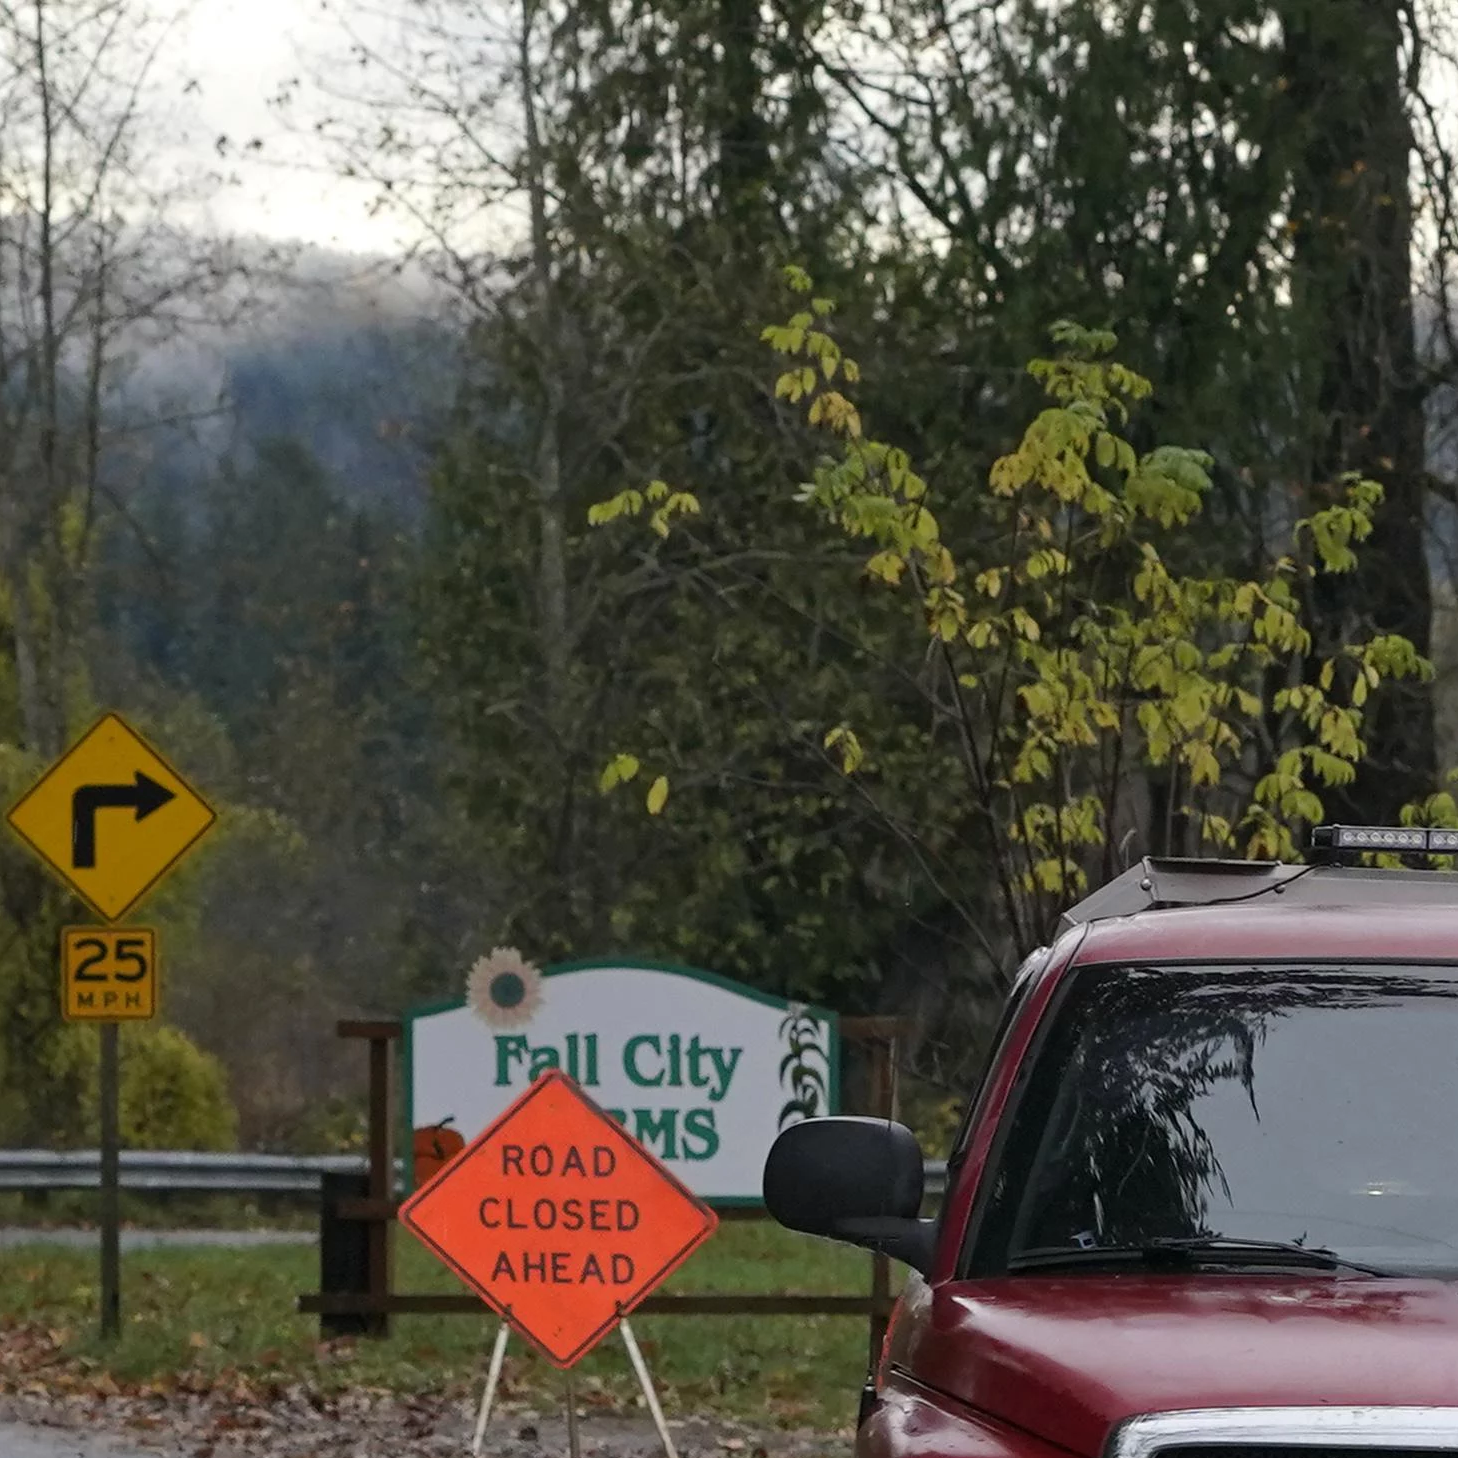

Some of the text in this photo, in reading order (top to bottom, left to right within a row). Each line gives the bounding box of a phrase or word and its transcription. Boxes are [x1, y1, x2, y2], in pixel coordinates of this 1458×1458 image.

[74, 937, 147, 982] 25
[77, 991, 141, 1009] MPH
[494, 1033, 743, 1102] Fall City
[502, 1144, 617, 1177] ROAD
[479, 1198, 640, 1231] CLOSED
[491, 1251, 635, 1285] AHEAD
